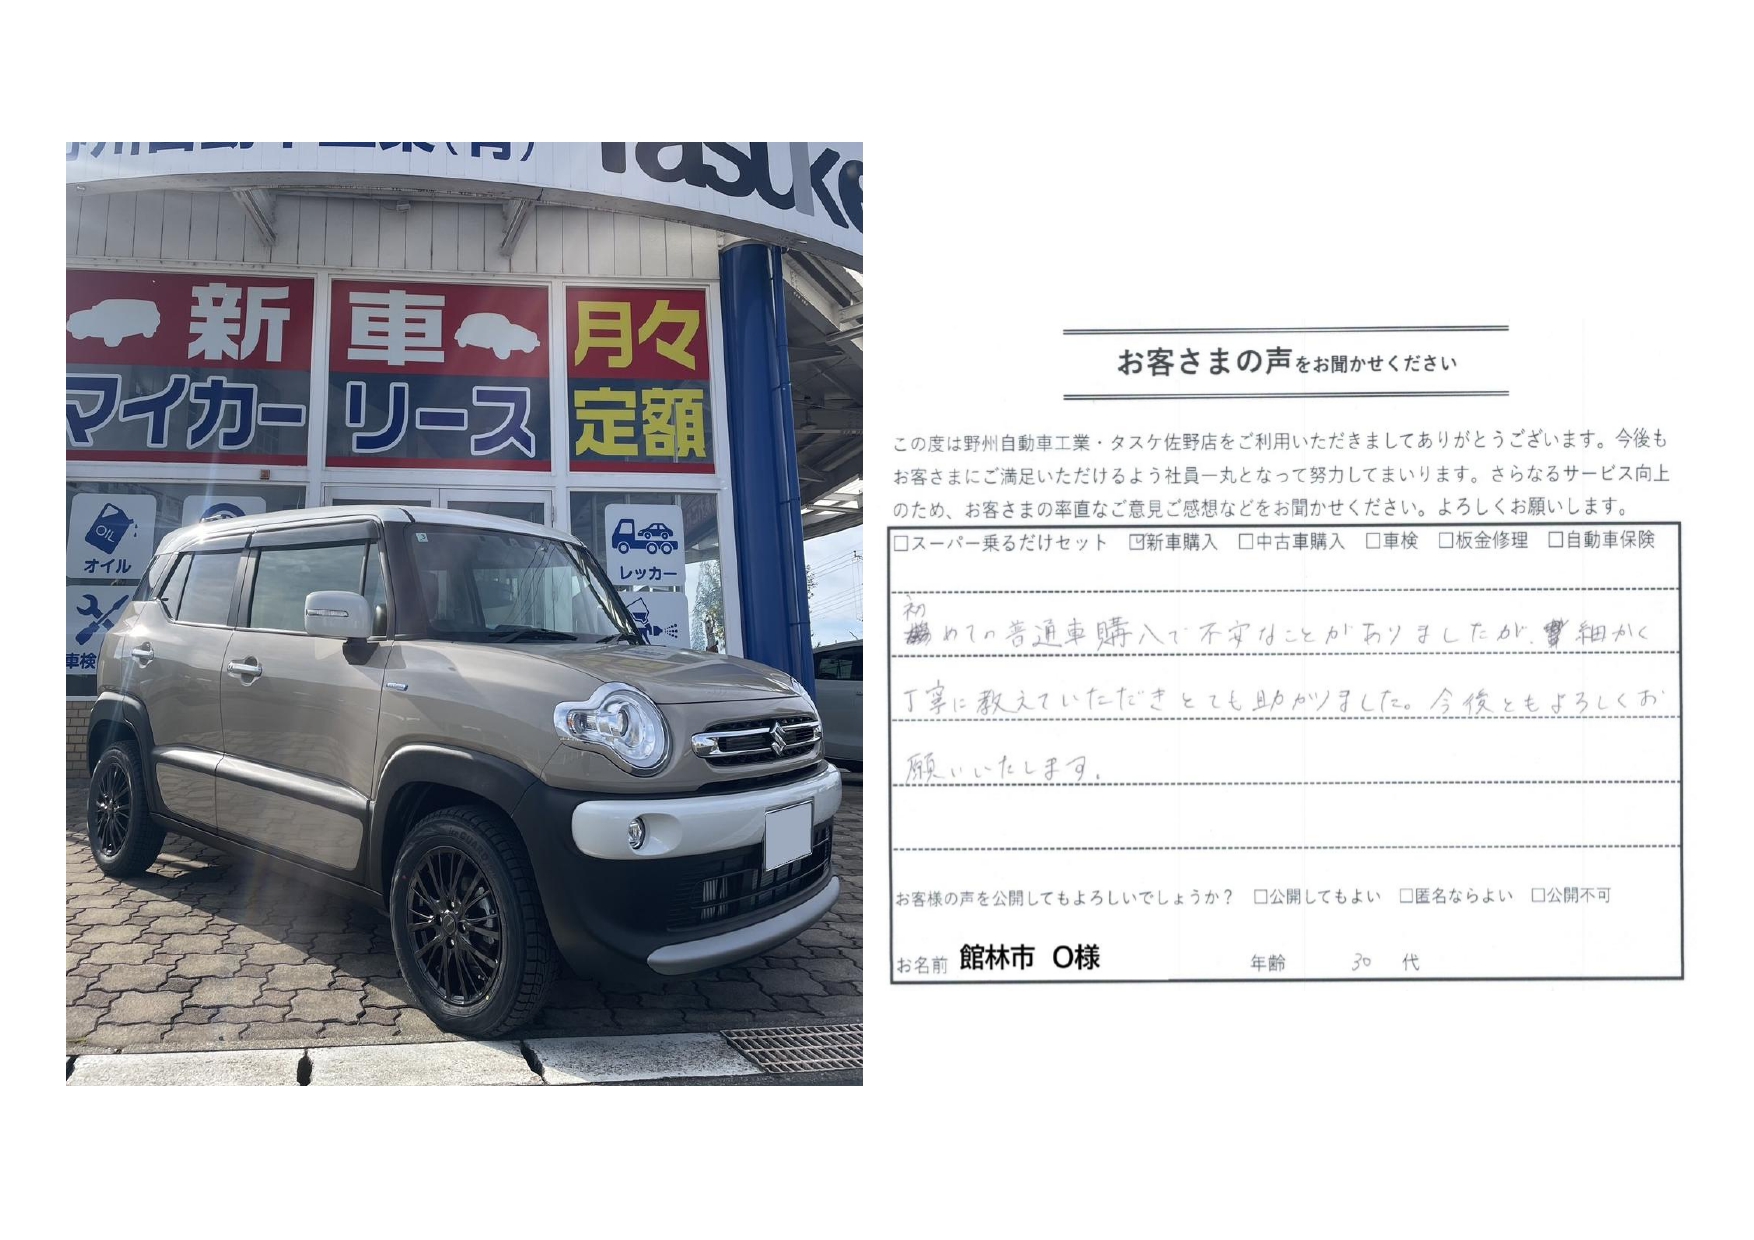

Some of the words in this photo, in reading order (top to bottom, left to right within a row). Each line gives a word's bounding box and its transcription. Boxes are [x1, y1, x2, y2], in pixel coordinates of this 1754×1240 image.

[188, 283, 291, 362] 新
[347, 290, 445, 366] 車
[574, 300, 700, 370] 月々
[66, 373, 306, 451] マイカー
[345, 381, 536, 458] リース
[574, 387, 707, 458] 定額
[95, 525, 115, 543] OIL
[911, 534, 1107, 552] スーパー乗るだけセット
[1147, 533, 1218, 552] 新車購入
[1257, 531, 1346, 551] 中古車購入
[1383, 531, 1419, 550] 車検
[1455, 531, 1529, 550] 板金修理
[1566, 530, 1656, 549] 自動車保険
[84, 559, 131, 574] オイル
[620, 566, 678, 581] レッカー
[66, 653, 96, 669] 車検
[1269, 888, 1382, 906] 公開してもよい
[1415, 887, 1514, 905] 匿名ならよい
[1547, 886, 1612, 905] 公開不可
[896, 955, 949, 974] お名前
[1250, 953, 1286, 972] 年齢
[1351, 953, 1372, 972] 30
[1402, 953, 1420, 972] 代
